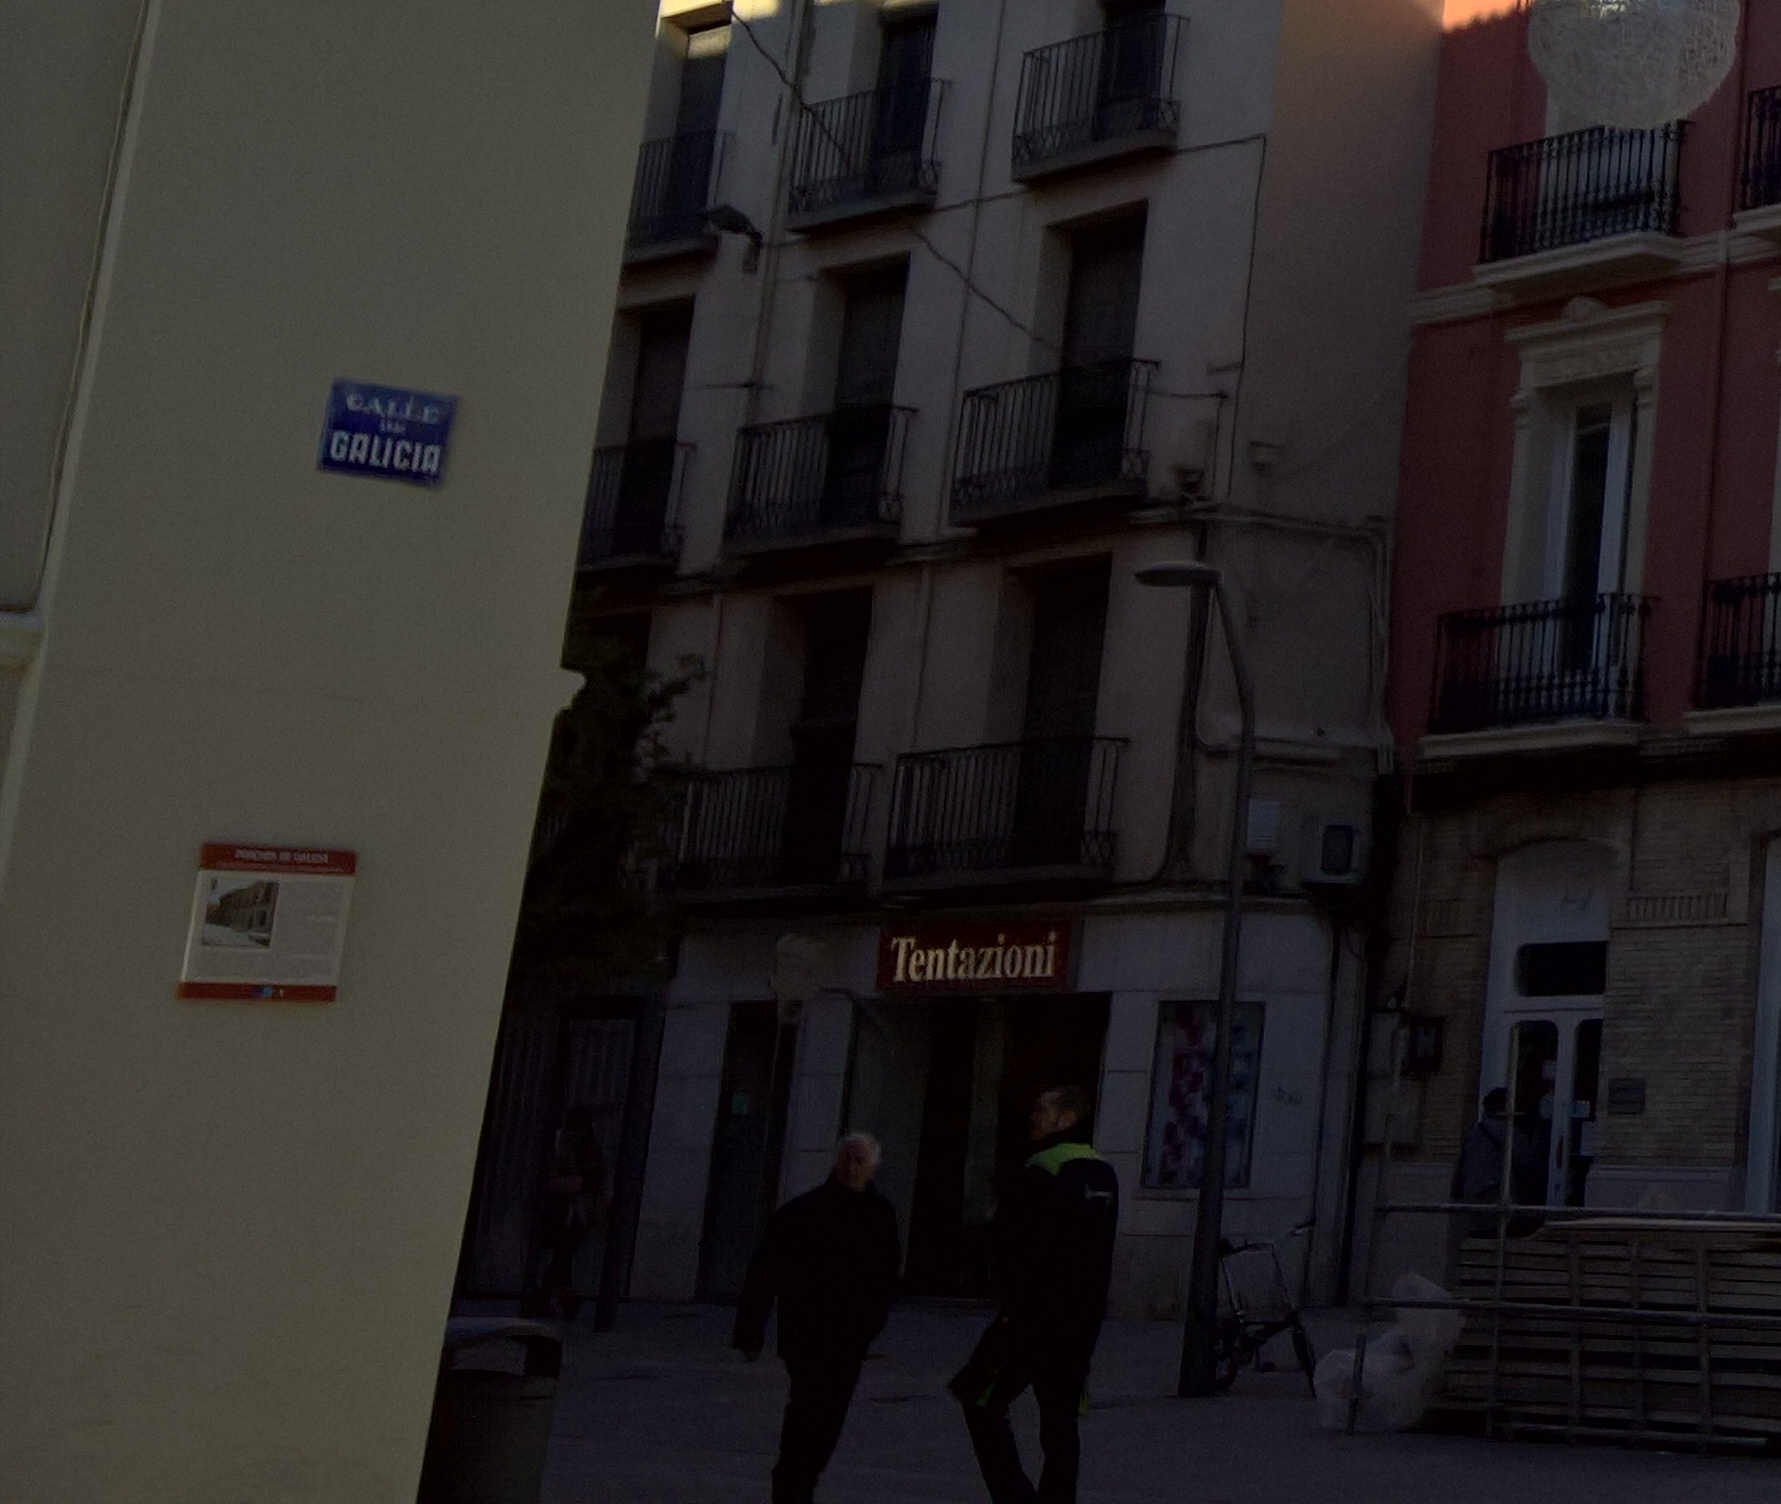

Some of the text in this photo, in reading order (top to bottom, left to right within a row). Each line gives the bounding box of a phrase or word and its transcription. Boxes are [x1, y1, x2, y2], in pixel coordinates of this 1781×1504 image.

[346, 392, 440, 424] CALLE
[330, 430, 441, 476] GALICIA
[891, 930, 1056, 983] Tentazioni
